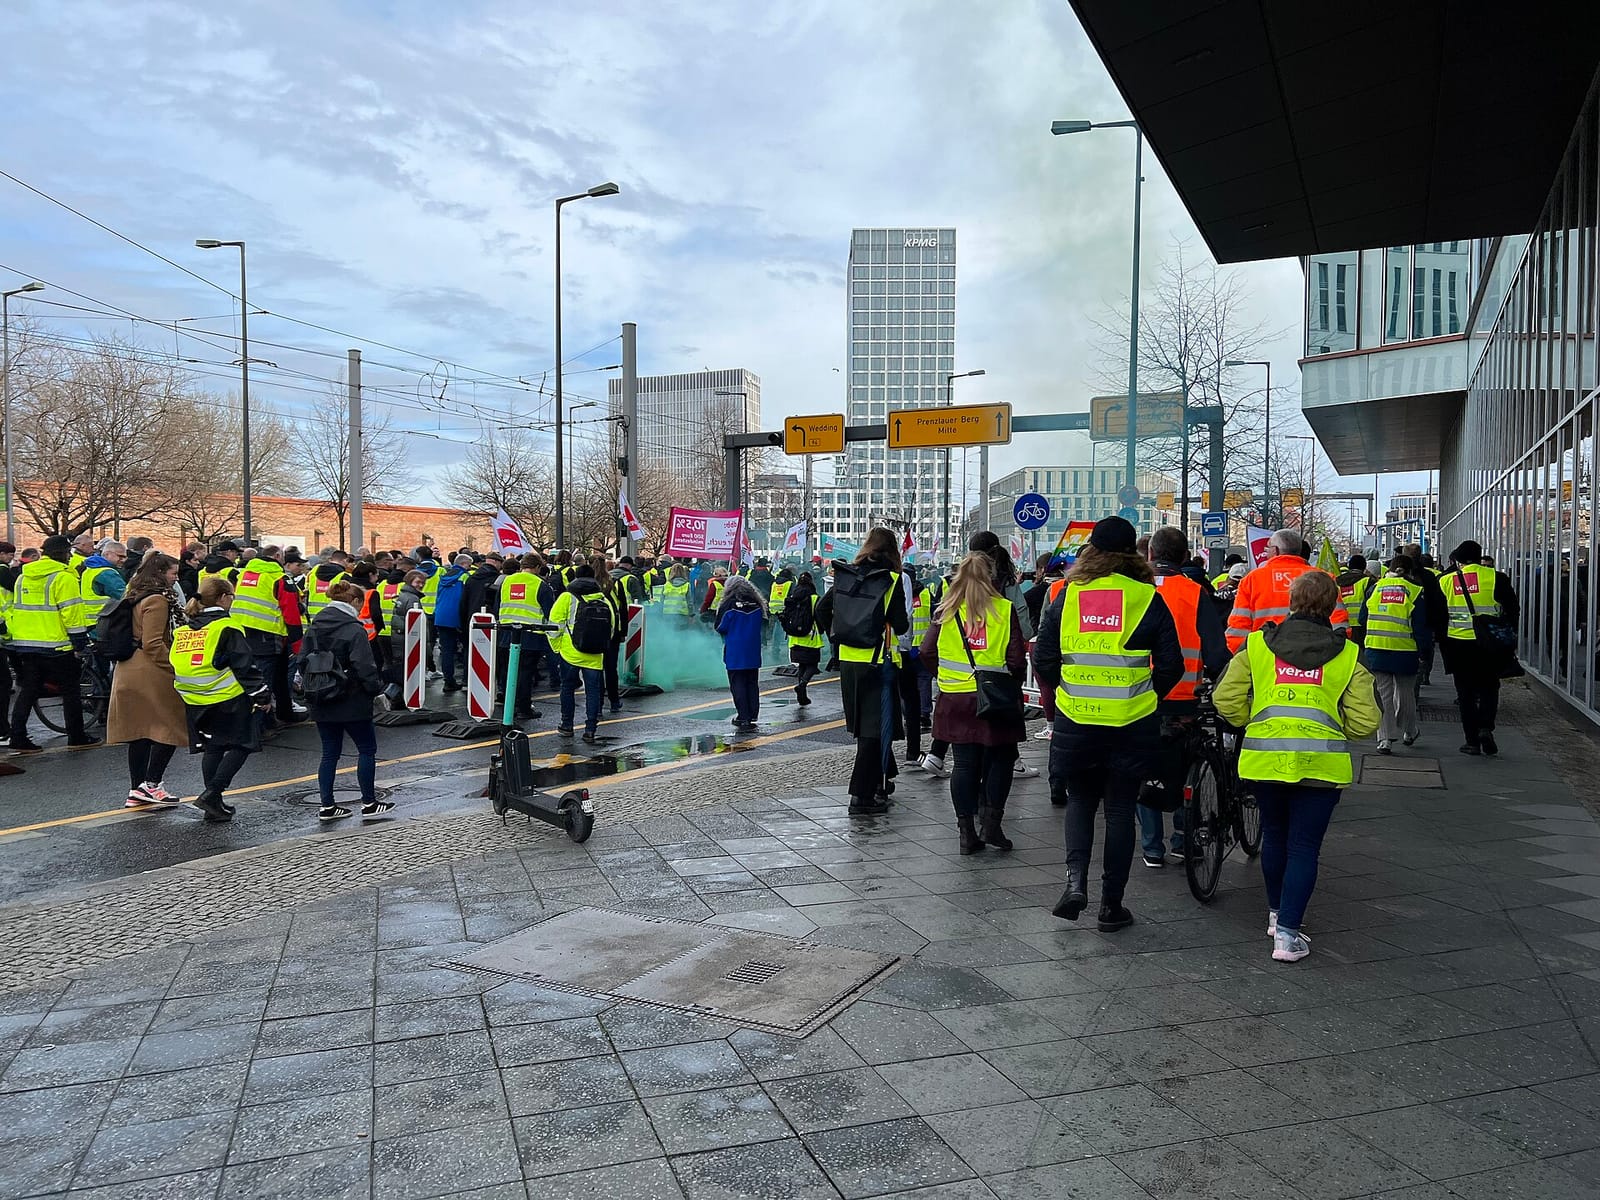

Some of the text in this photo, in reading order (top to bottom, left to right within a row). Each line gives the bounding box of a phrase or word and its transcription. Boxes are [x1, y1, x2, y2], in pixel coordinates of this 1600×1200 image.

[904, 238, 937, 247] KPMG
[917, 415, 980, 425] Prenzlauer Berg
[808, 424, 838, 432] Wedding
[1275, 572, 1296, 588] BS
[1082, 614, 1120, 627] ver.di
[1278, 666, 1320, 680] ver.di
